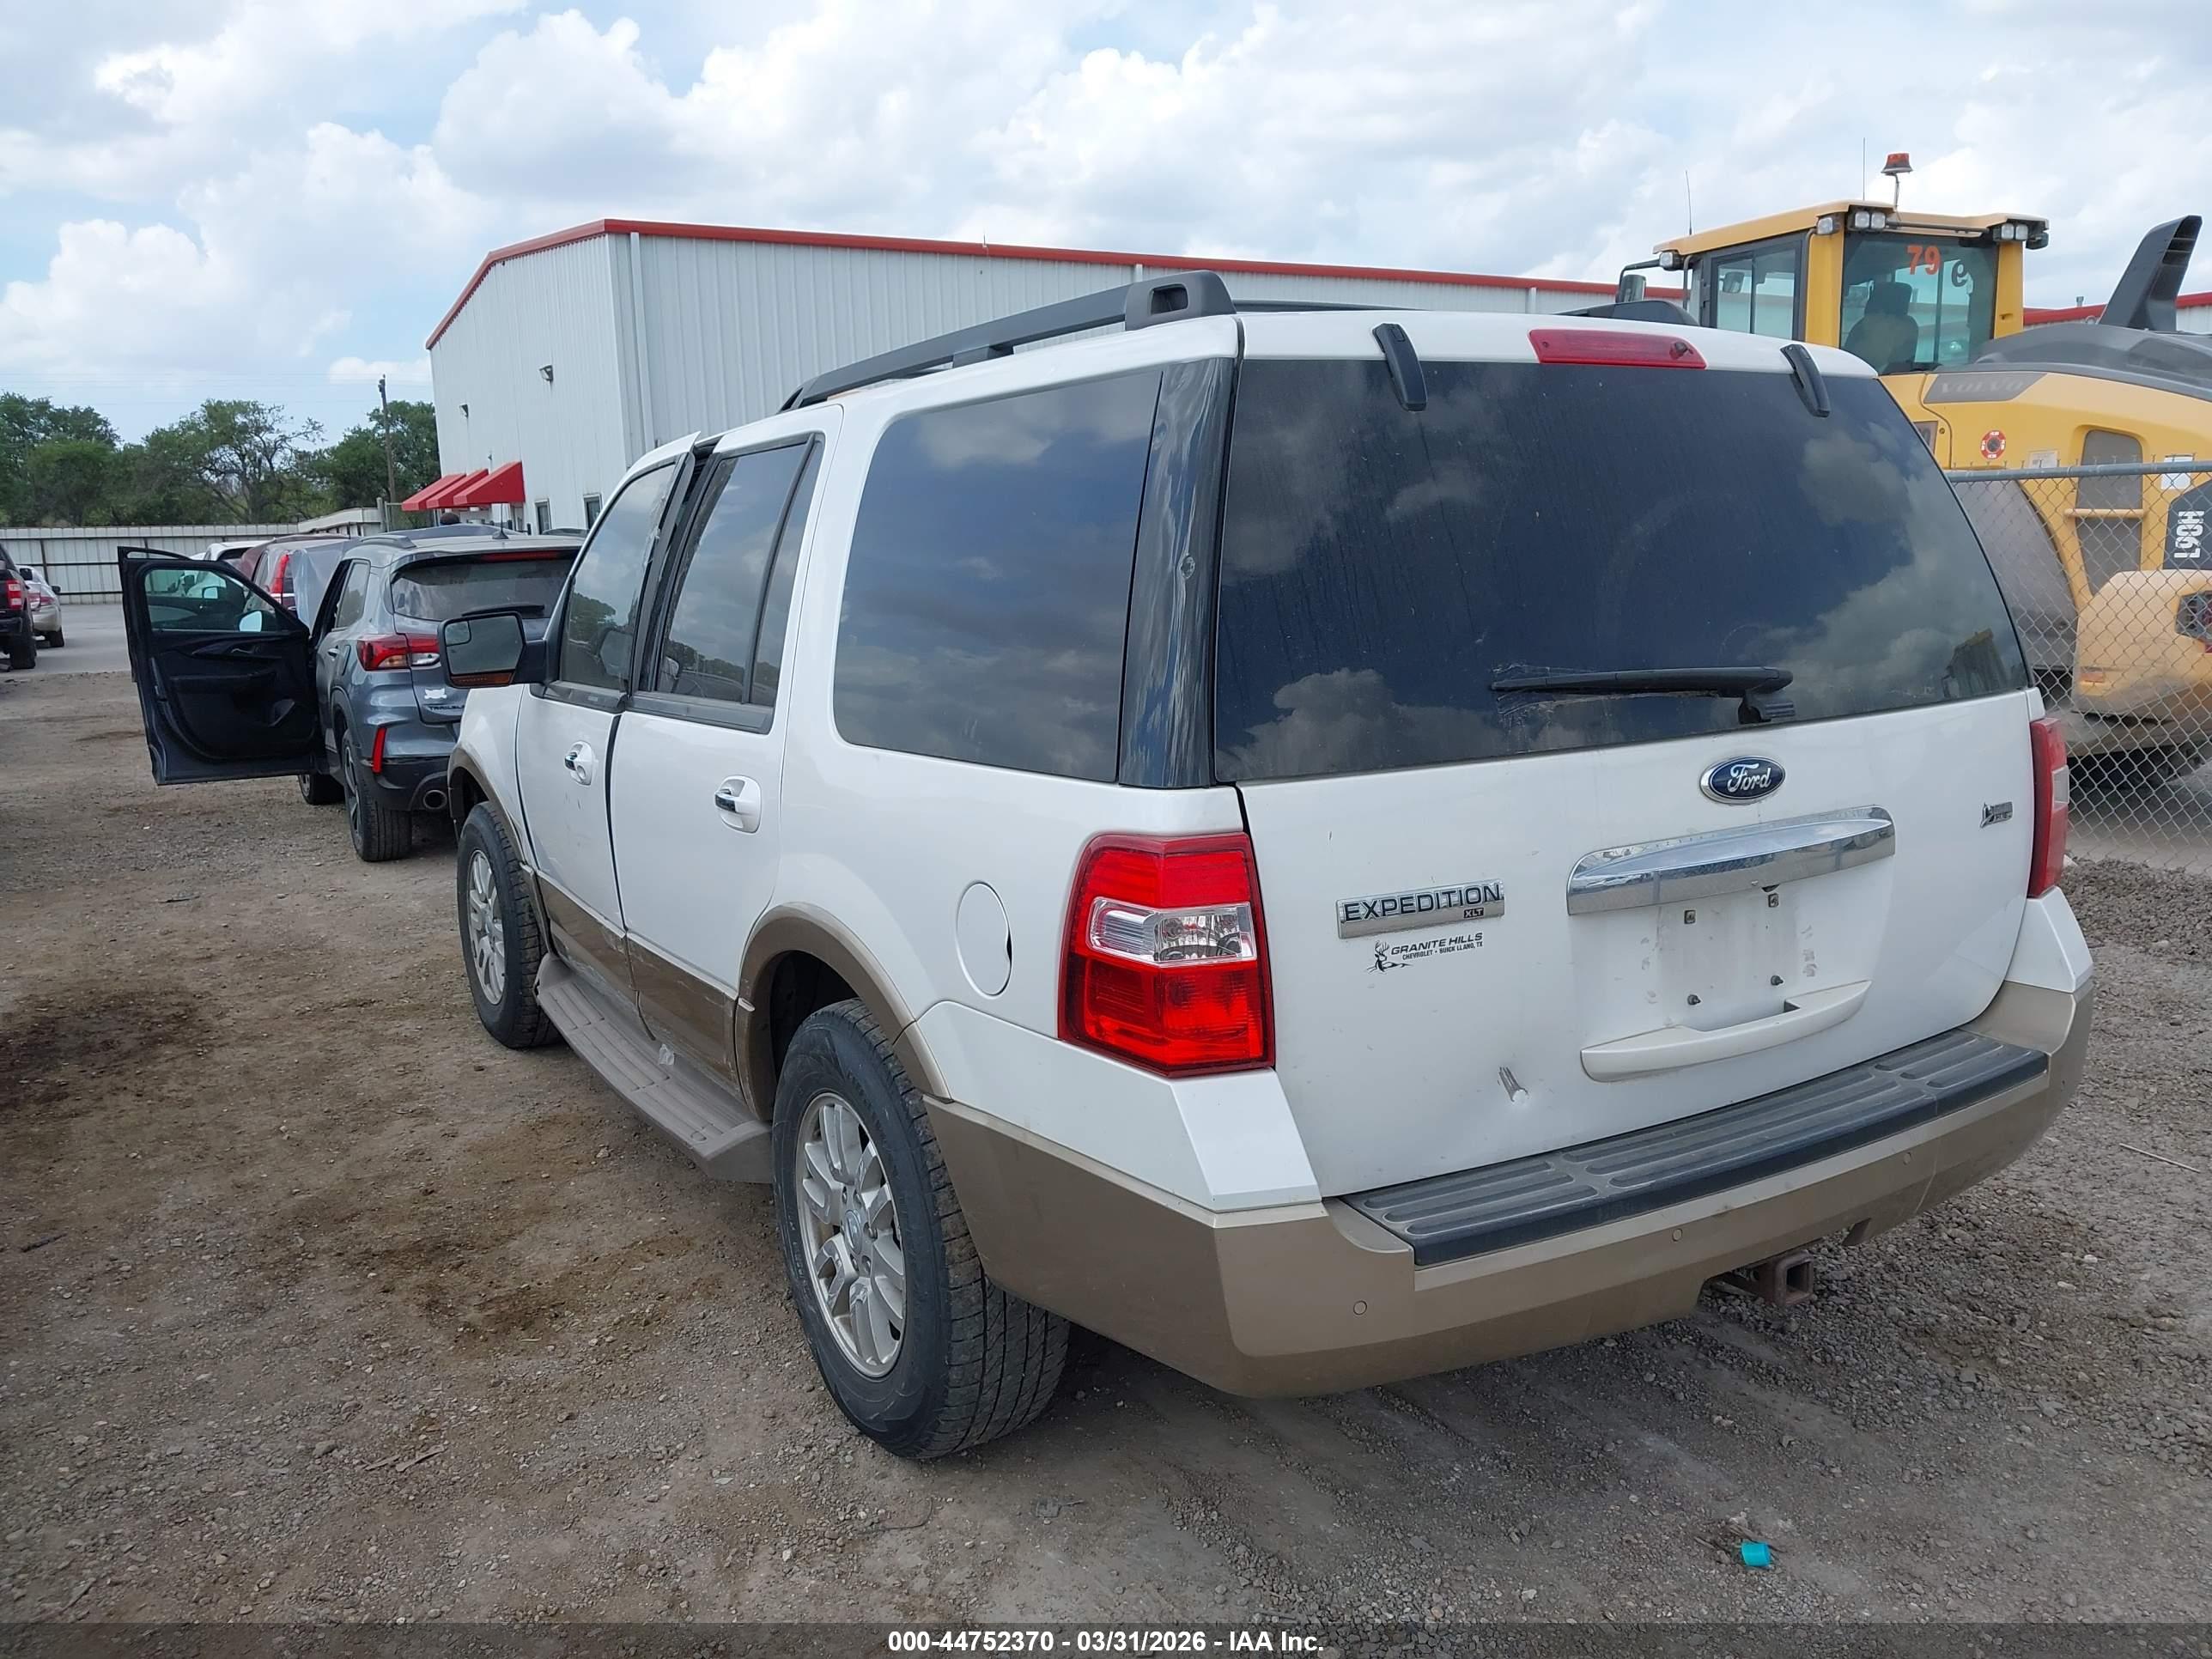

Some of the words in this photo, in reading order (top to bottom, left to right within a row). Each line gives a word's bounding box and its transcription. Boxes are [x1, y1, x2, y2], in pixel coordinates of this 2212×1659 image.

[1906, 245, 1941, 276] 79
[2173, 510, 2205, 558] L90H
[1726, 763, 1772, 793] Ford
[1344, 883, 1501, 921] EXPEDITION
[1464, 908, 1484, 919] XLT
[1390, 938, 1448, 956] GRANITE
[1449, 933, 1484, 945] HILLS
[1401, 949, 1433, 961] CHEVROLET
